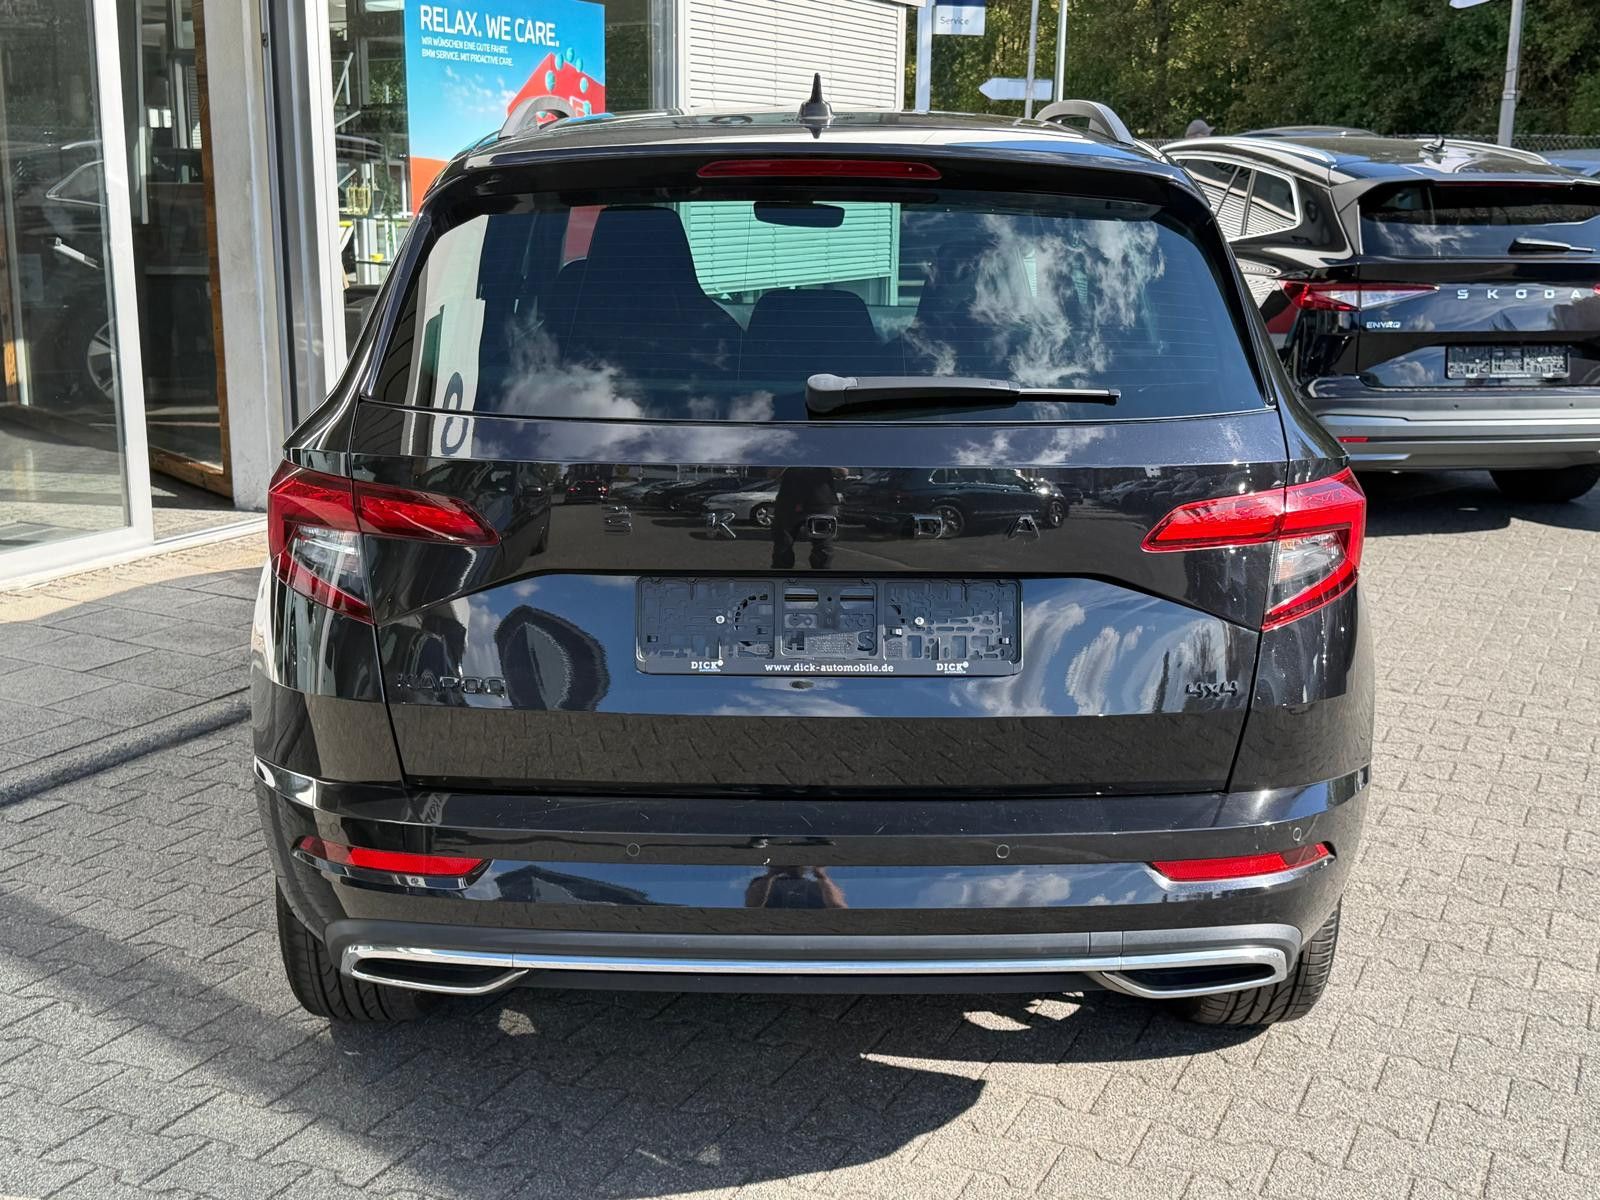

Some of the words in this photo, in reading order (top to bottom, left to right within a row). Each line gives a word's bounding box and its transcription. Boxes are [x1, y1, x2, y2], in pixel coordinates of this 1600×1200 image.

[939, 16, 970, 25] Service
[420, 4, 482, 37] RELAX.
[485, 13, 511, 41] WE
[514, 18, 560, 48] CARE.
[1366, 321, 1401, 329] ENYAQ
[690, 661, 718, 669] DICK
[764, 663, 895, 673] www.dick-automobile.de
[936, 663, 963, 671] DICK
